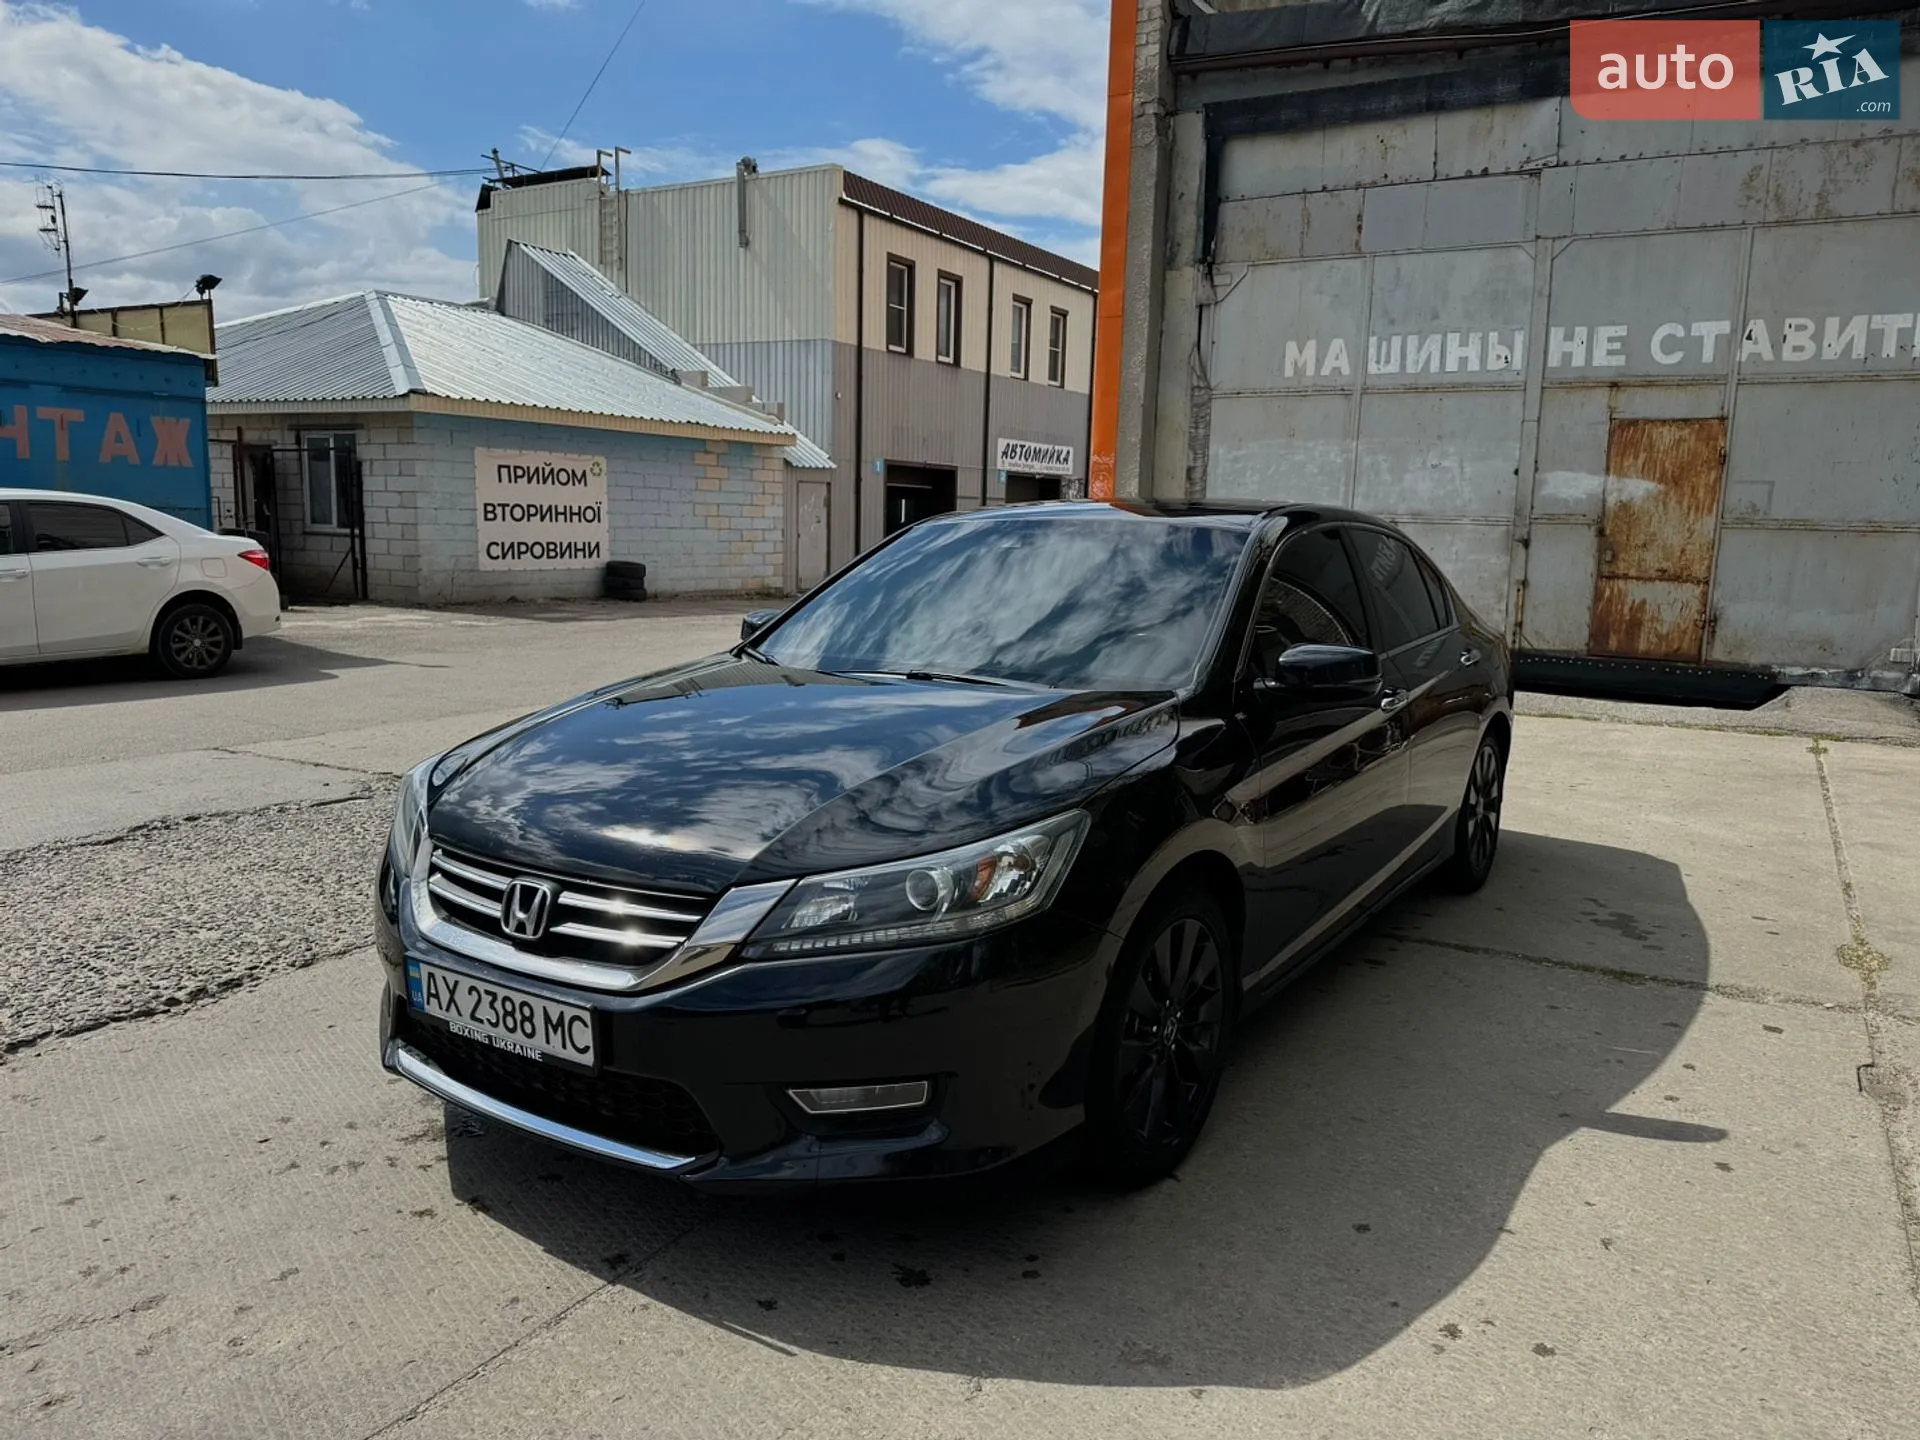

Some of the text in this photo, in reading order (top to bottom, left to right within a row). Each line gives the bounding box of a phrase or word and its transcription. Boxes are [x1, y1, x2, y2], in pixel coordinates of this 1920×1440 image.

[1547, 325, 1628, 367] НЕ
[1650, 313, 1920, 365] СТАВИТ
[1001, 443, 1071, 465] АВТОМИЙКА
[497, 462, 588, 487] ПРИЙОМ
[483, 501, 602, 523] ВТОРИННОЇ
[486, 541, 600, 560] СИРОВИНИ
[426, 971, 591, 1055] AX 2388 MC
[449, 1022, 543, 1062] BOXING UKRAINE
